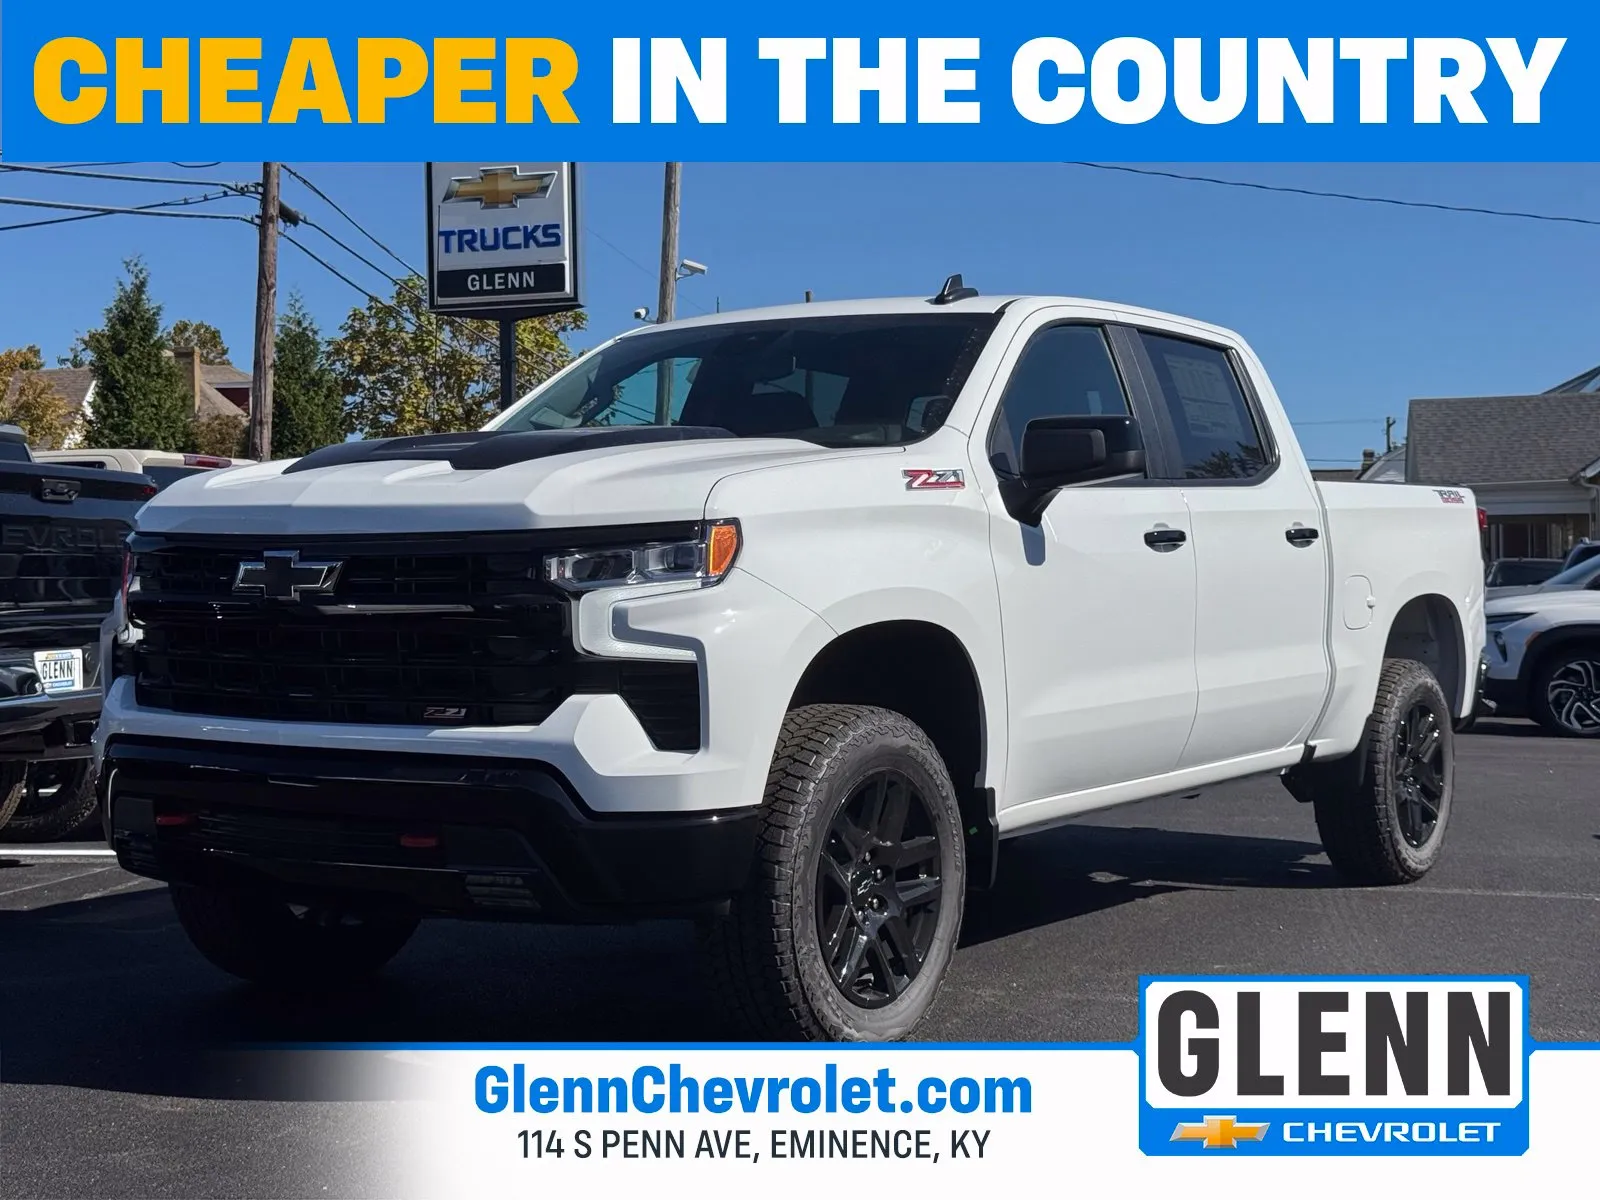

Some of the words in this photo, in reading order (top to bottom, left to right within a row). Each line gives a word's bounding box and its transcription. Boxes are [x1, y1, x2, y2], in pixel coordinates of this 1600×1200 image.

[438, 223, 562, 254] TRUCKS
[466, 271, 536, 292] GLENN
[42, 660, 73, 680] GLENN
